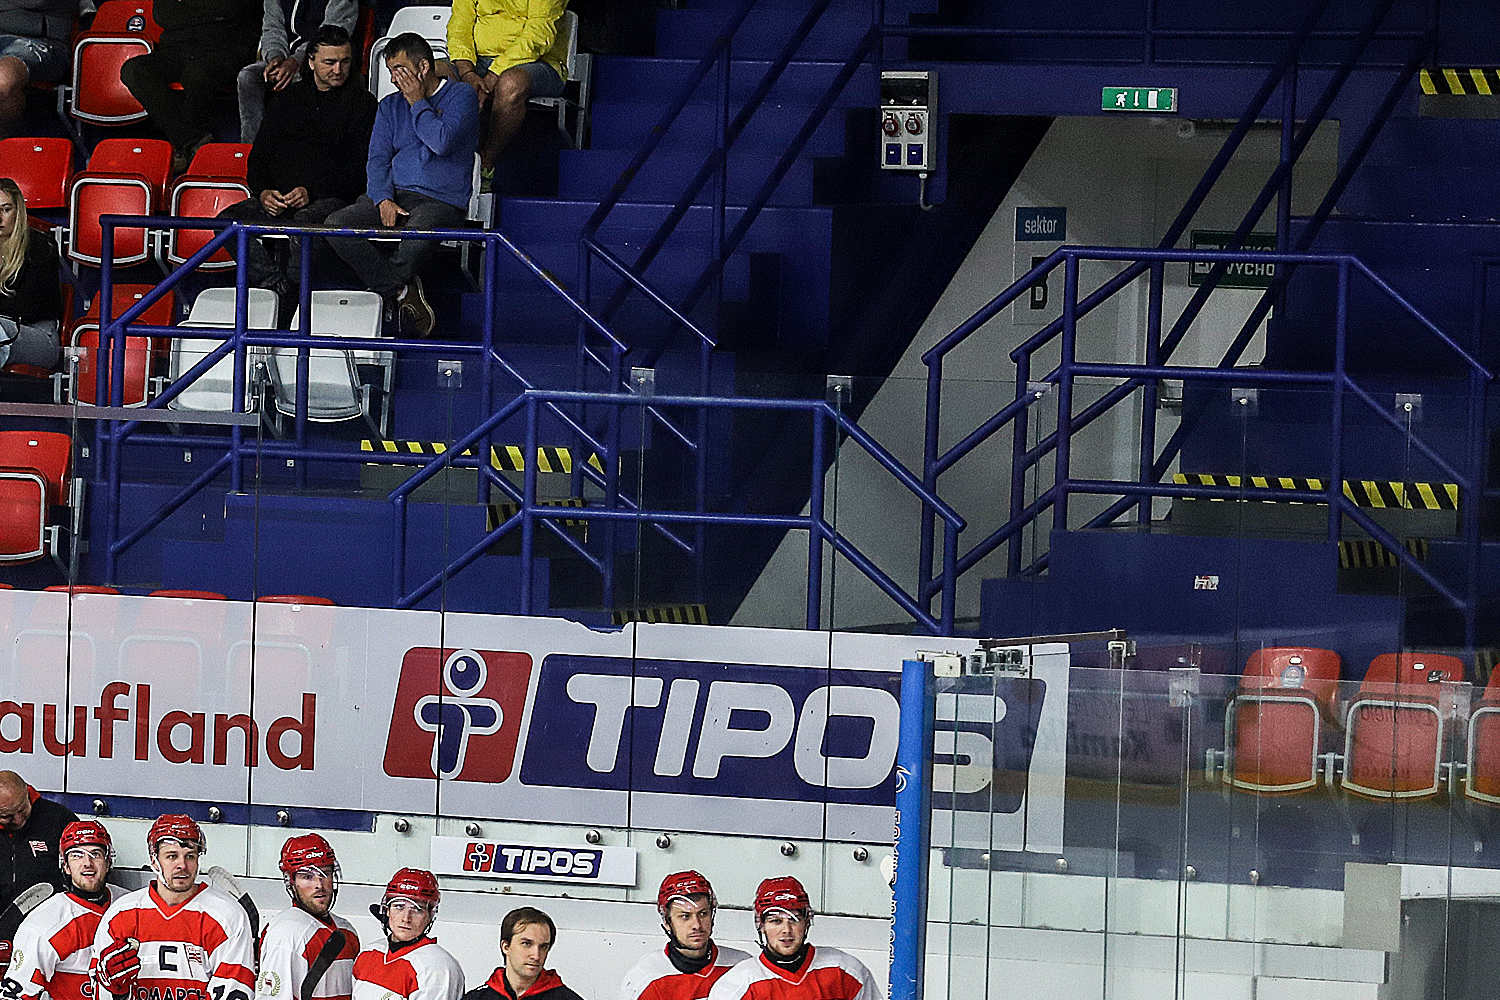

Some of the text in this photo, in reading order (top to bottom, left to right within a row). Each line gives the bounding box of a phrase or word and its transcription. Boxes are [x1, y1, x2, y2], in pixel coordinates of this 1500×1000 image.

[1024, 214, 1058, 234] sektor
[566, 672, 1007, 796] TIPOS
[501, 848, 596, 875] TIPOS
[158, 944, 179, 972] C
